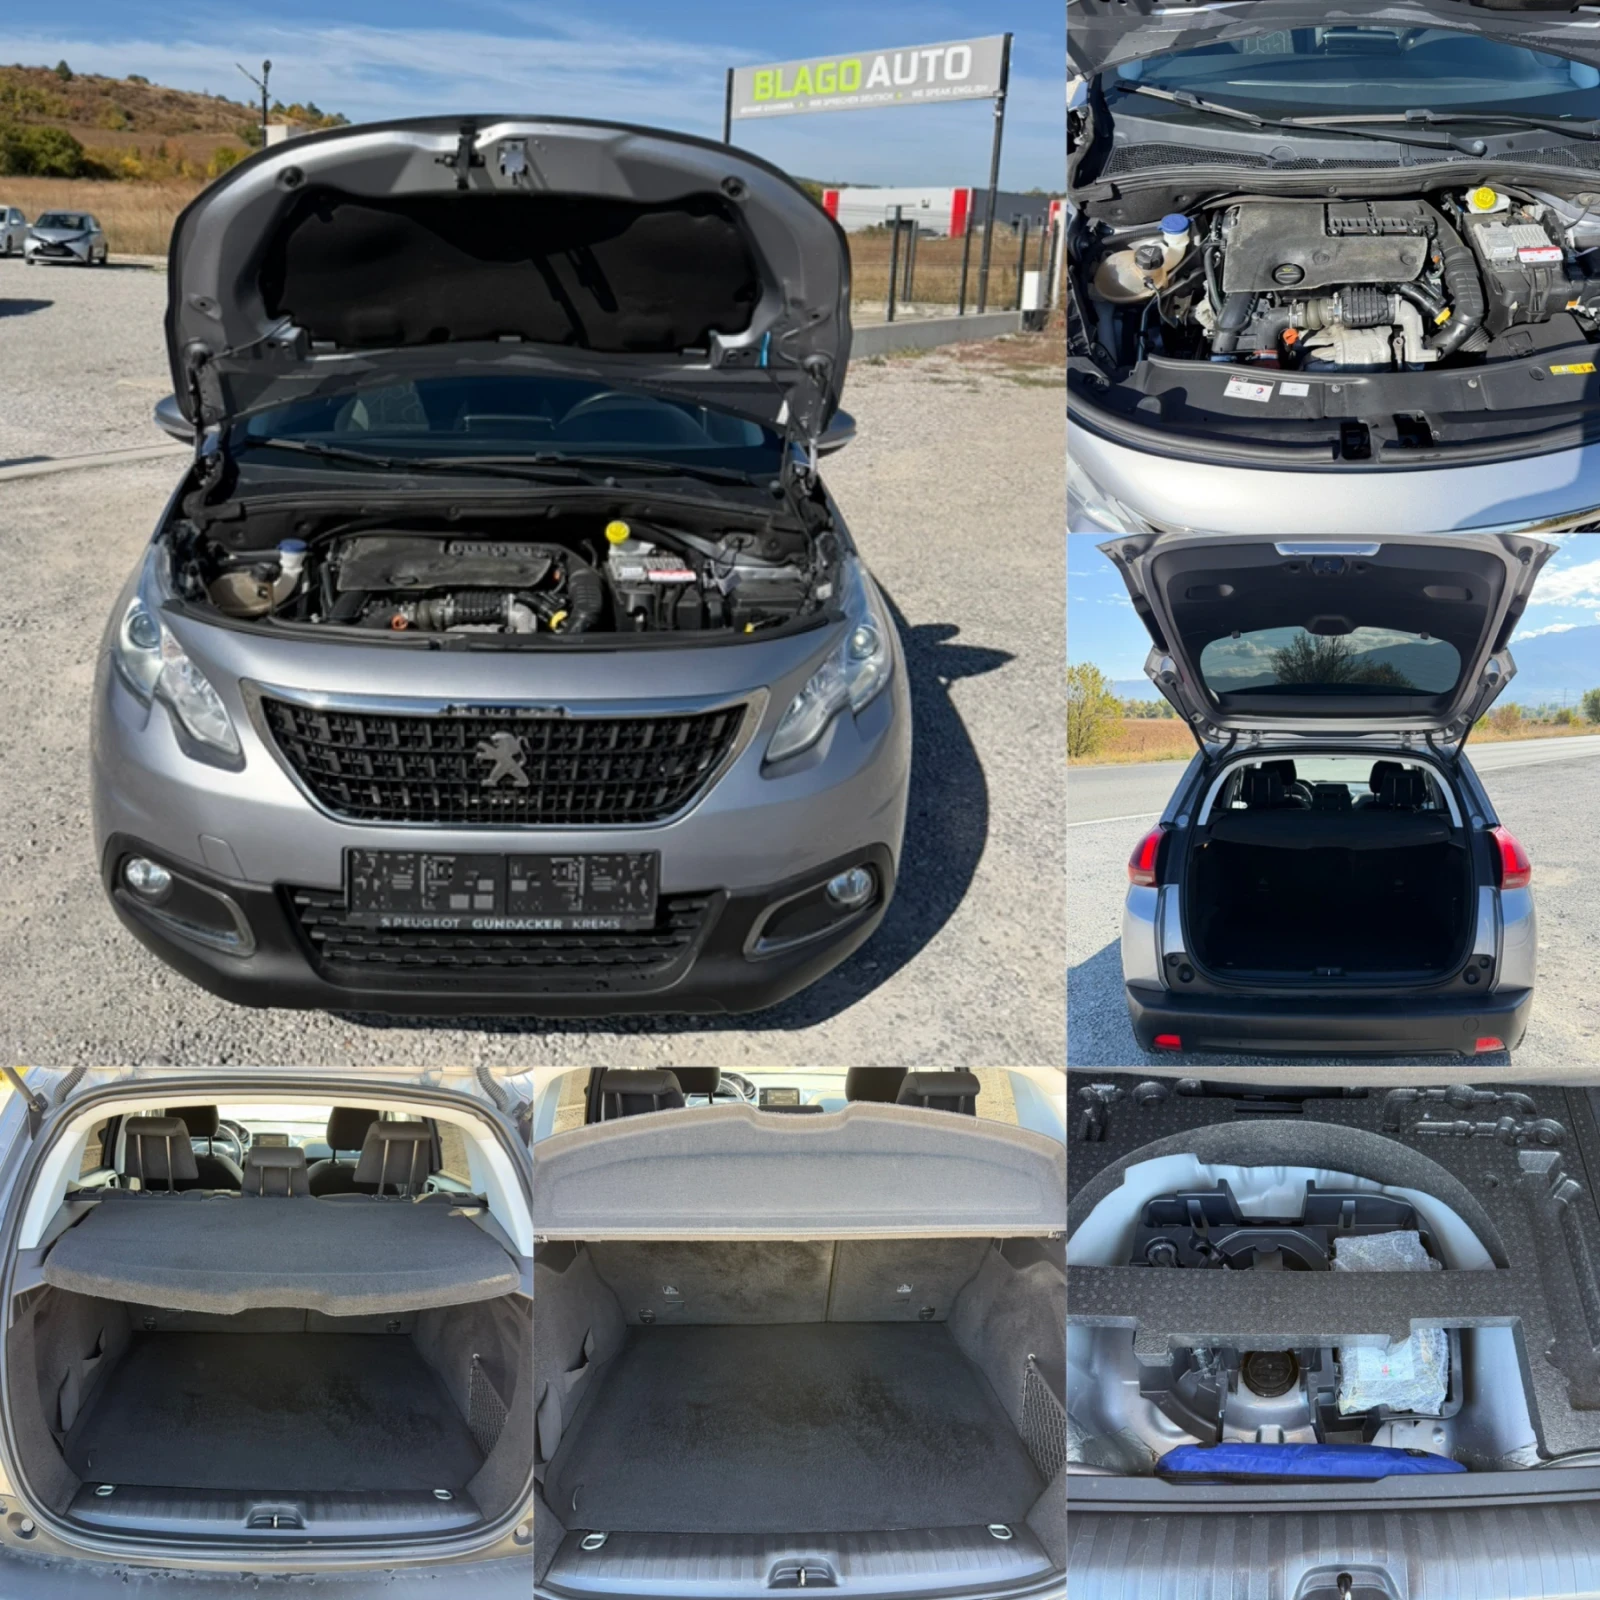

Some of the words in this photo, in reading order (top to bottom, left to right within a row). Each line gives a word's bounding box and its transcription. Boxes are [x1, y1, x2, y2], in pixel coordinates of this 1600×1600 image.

[753, 59, 862, 101] BLAGO
[865, 44, 972, 89] AUTO
[925, 87, 951, 97] SPEAK
[393, 918, 460, 929] PEUGEOT
[472, 918, 562, 930] GUNDACKER
[572, 918, 620, 930] KREMS
